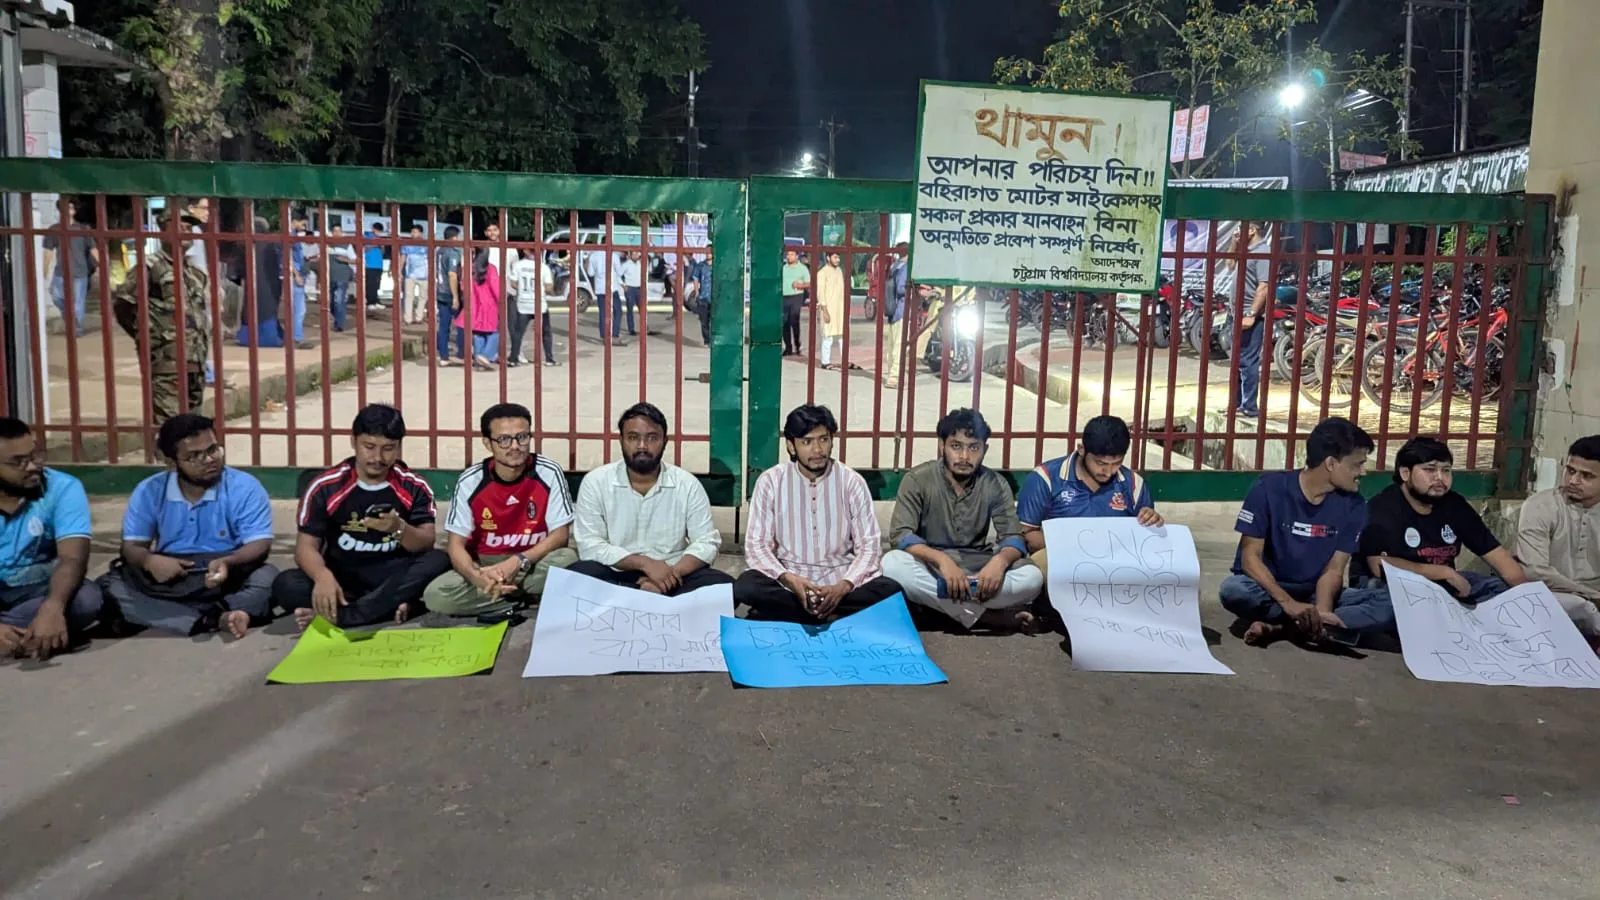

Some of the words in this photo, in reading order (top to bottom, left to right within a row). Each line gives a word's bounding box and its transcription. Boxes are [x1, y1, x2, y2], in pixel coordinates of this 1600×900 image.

[975, 104, 1106, 160] থামুন
[927, 154, 1018, 180] আপনার
[1028, 158, 1102, 186] পরিচয়
[919, 177, 1002, 203] বহিরাগত
[1006, 182, 1064, 206] মোটর
[919, 208, 966, 224] সকল
[968, 208, 1020, 228] প্রকার
[1021, 212, 1087, 235] যানবাহন
[1093, 211, 1143, 235] বিনা
[919, 226, 992, 252] অনুমতিতে
[993, 231, 1037, 248] প্রবেশ
[1012, 264, 1048, 282] চট্টগ্রাম
[1049, 265, 1108, 282] বিশ্ববিদ্যালয়
[485, 528, 547, 548] bwin
[1077, 528, 1176, 572] CNG
